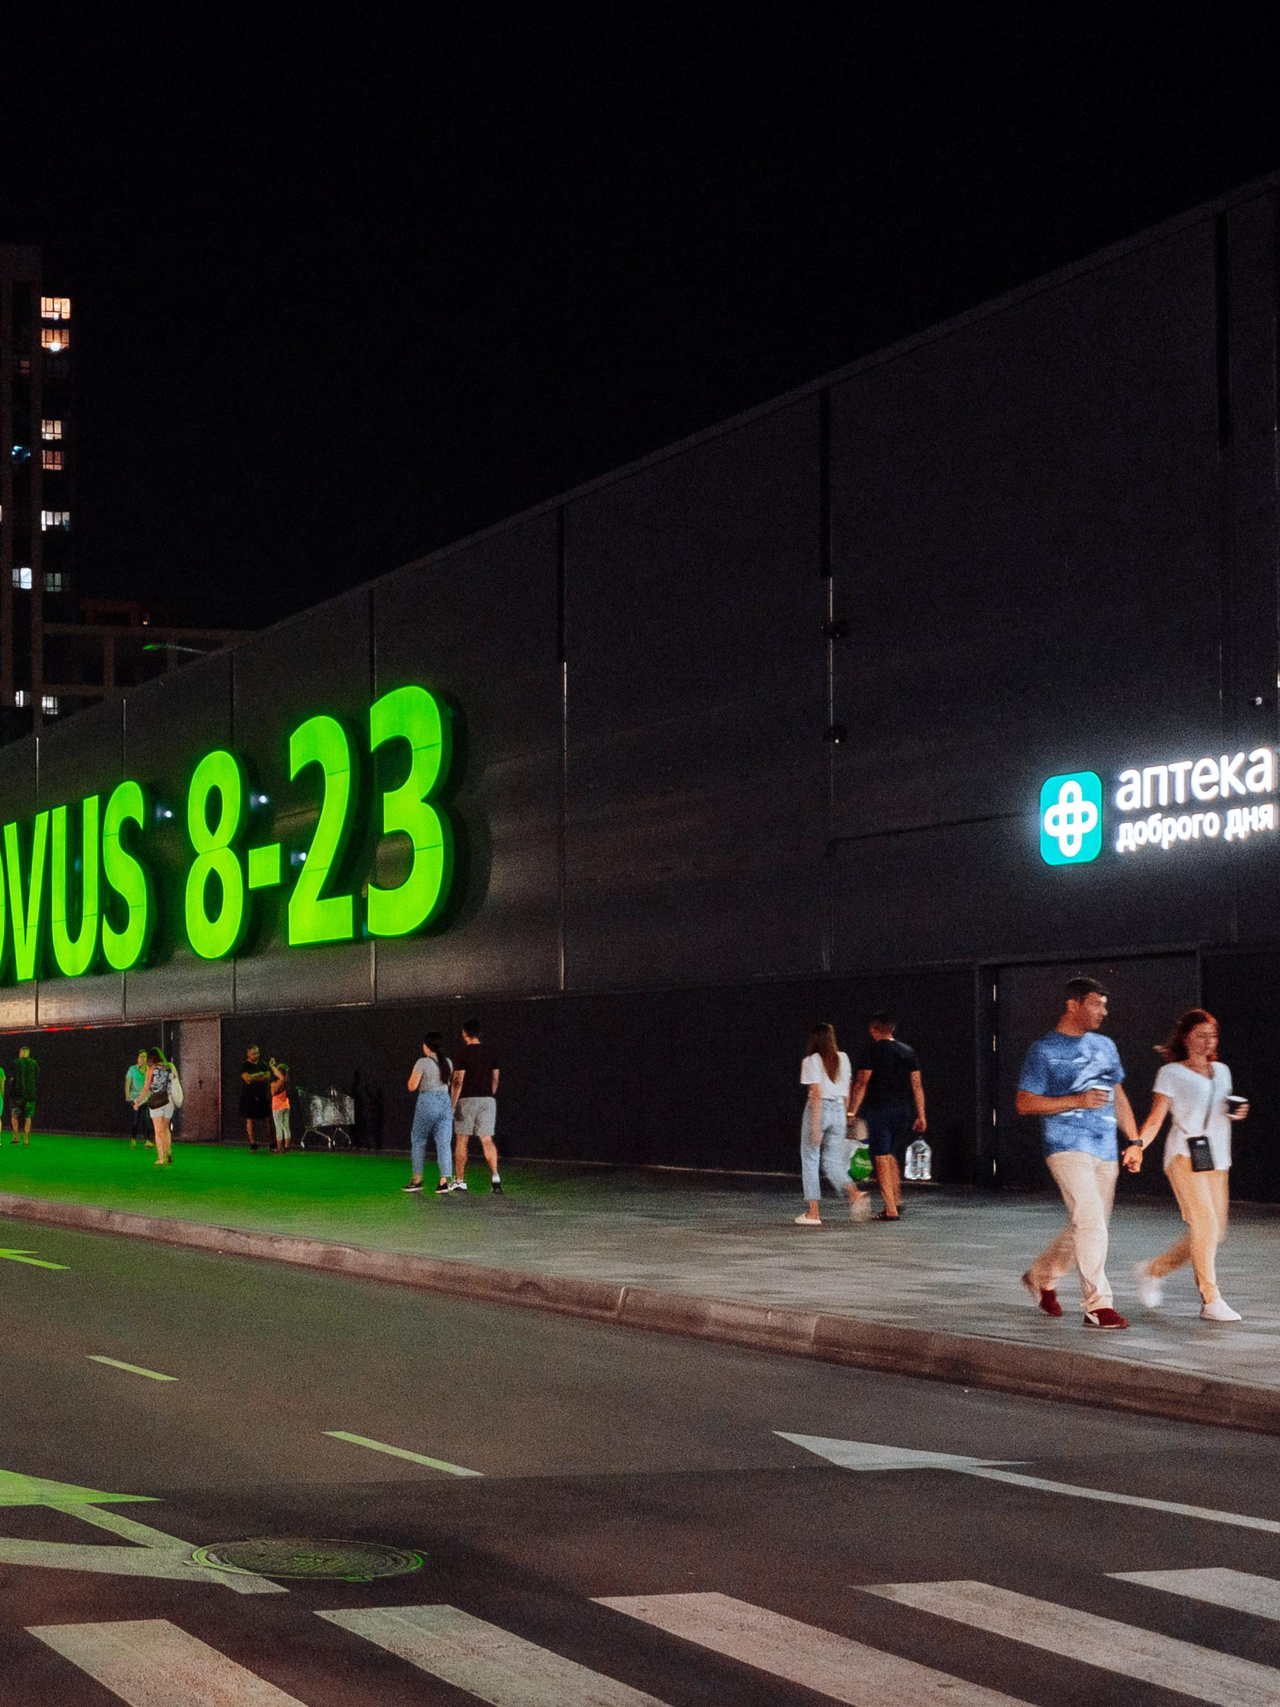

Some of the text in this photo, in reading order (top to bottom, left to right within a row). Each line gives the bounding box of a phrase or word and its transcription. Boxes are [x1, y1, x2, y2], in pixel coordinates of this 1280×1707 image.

[1115, 747, 1275, 811] аптека
[185, 685, 448, 959] 8-23
[1116, 804, 1275, 853] доброго дня
